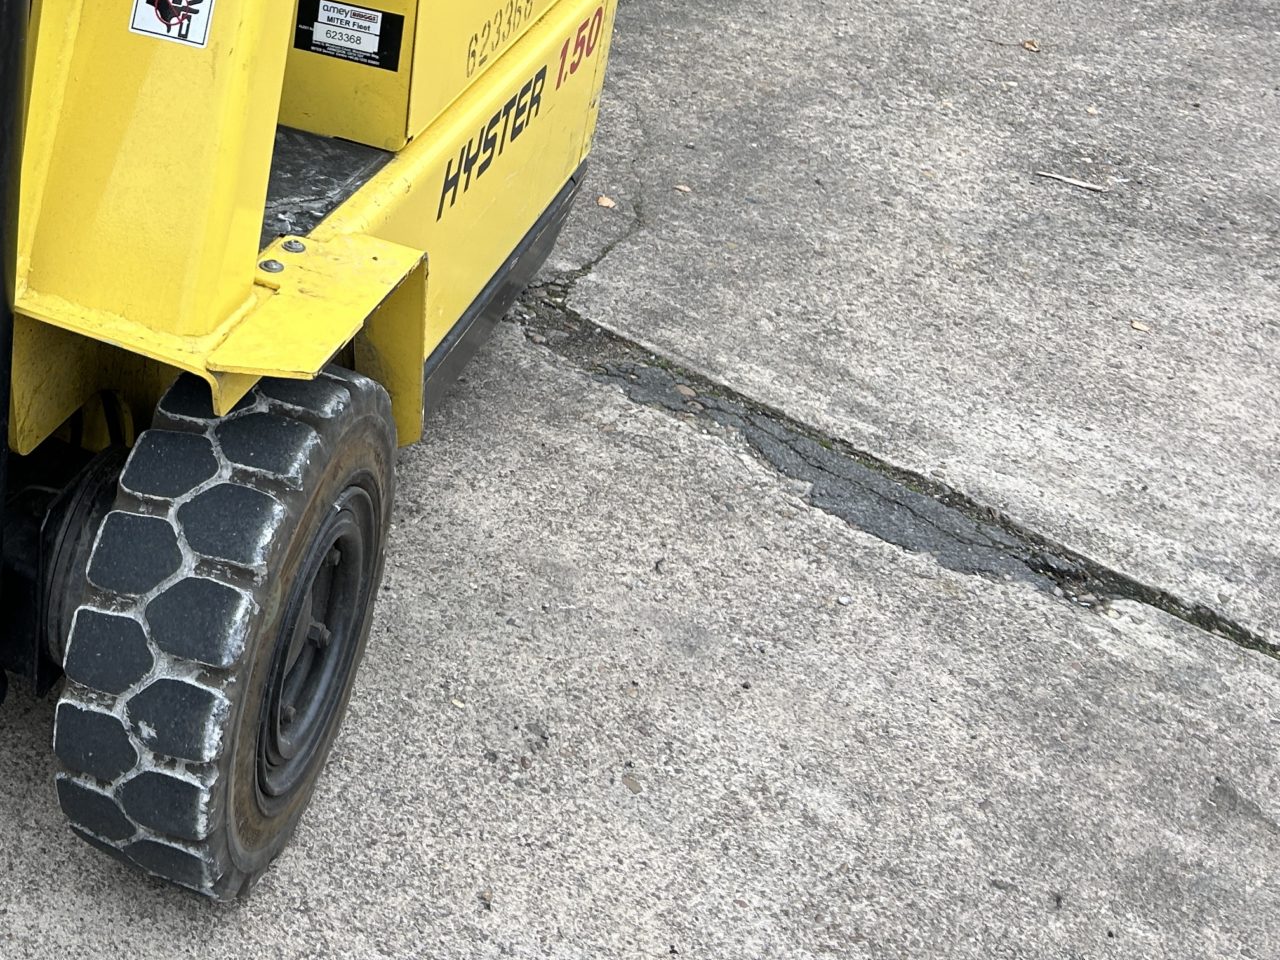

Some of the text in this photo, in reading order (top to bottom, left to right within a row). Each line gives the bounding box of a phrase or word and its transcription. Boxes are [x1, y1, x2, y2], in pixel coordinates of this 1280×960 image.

[322, 4, 350, 18] amey
[326, 15, 350, 27] MITER
[325, 29, 362, 45] 623368
[556, 6, 603, 90] 1.50
[436, 64, 547, 222] HYSTER
